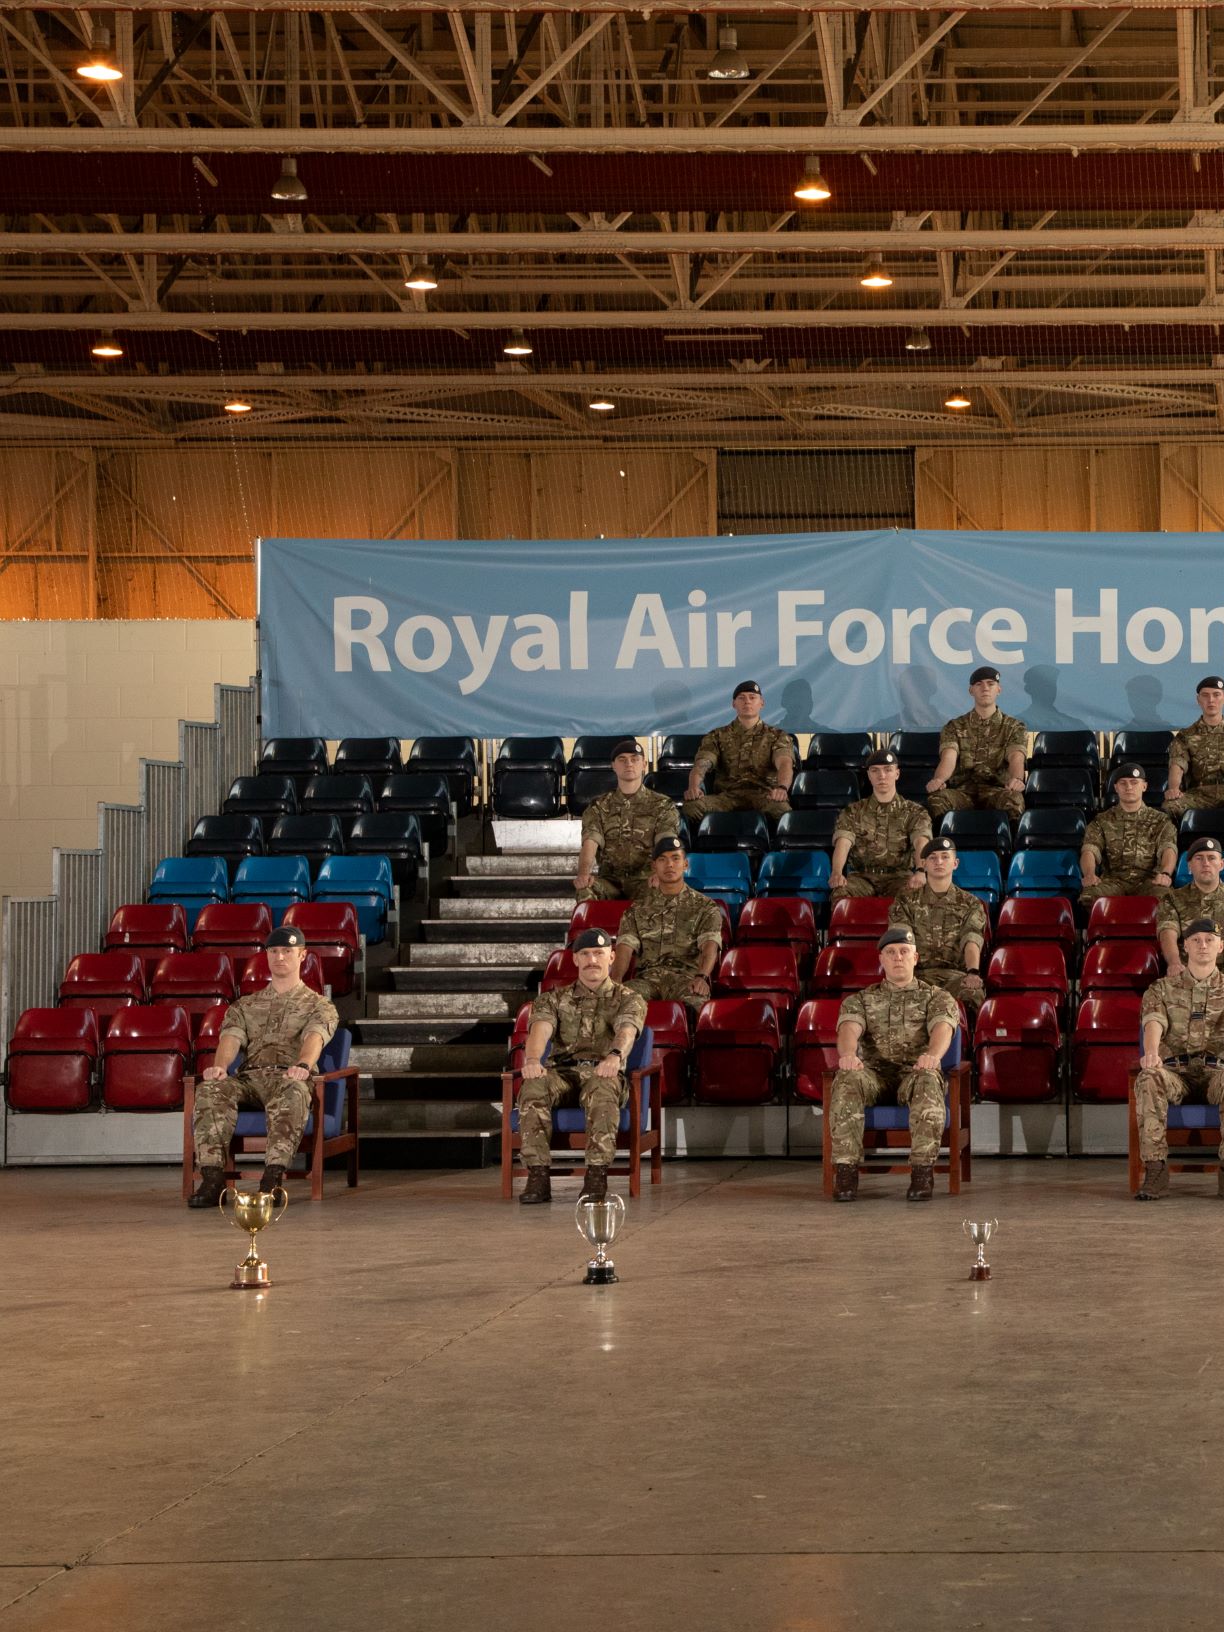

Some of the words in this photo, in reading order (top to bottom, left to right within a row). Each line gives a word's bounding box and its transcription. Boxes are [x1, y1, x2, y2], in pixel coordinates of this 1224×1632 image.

[333, 590, 589, 696] Royal
[614, 589, 753, 670] Air
[777, 589, 1028, 667] Force
